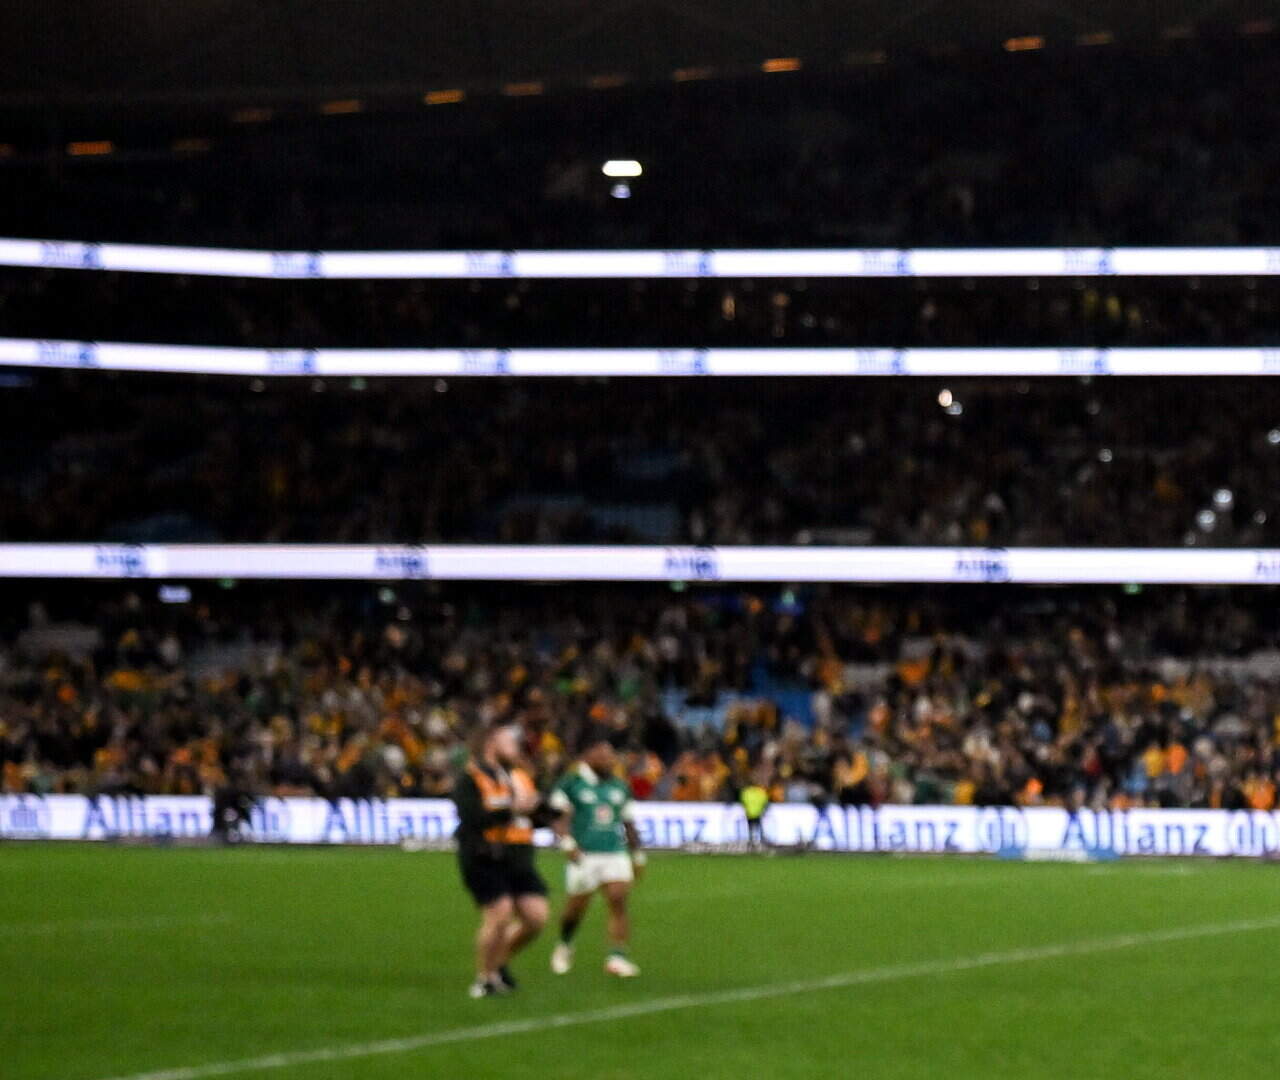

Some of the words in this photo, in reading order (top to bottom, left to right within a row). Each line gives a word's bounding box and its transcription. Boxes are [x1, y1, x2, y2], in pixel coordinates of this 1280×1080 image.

[84, 795, 209, 838] Allian
[324, 798, 443, 842] Allian
[812, 804, 962, 851] Allianz
[1062, 809, 1210, 853] Allianz
